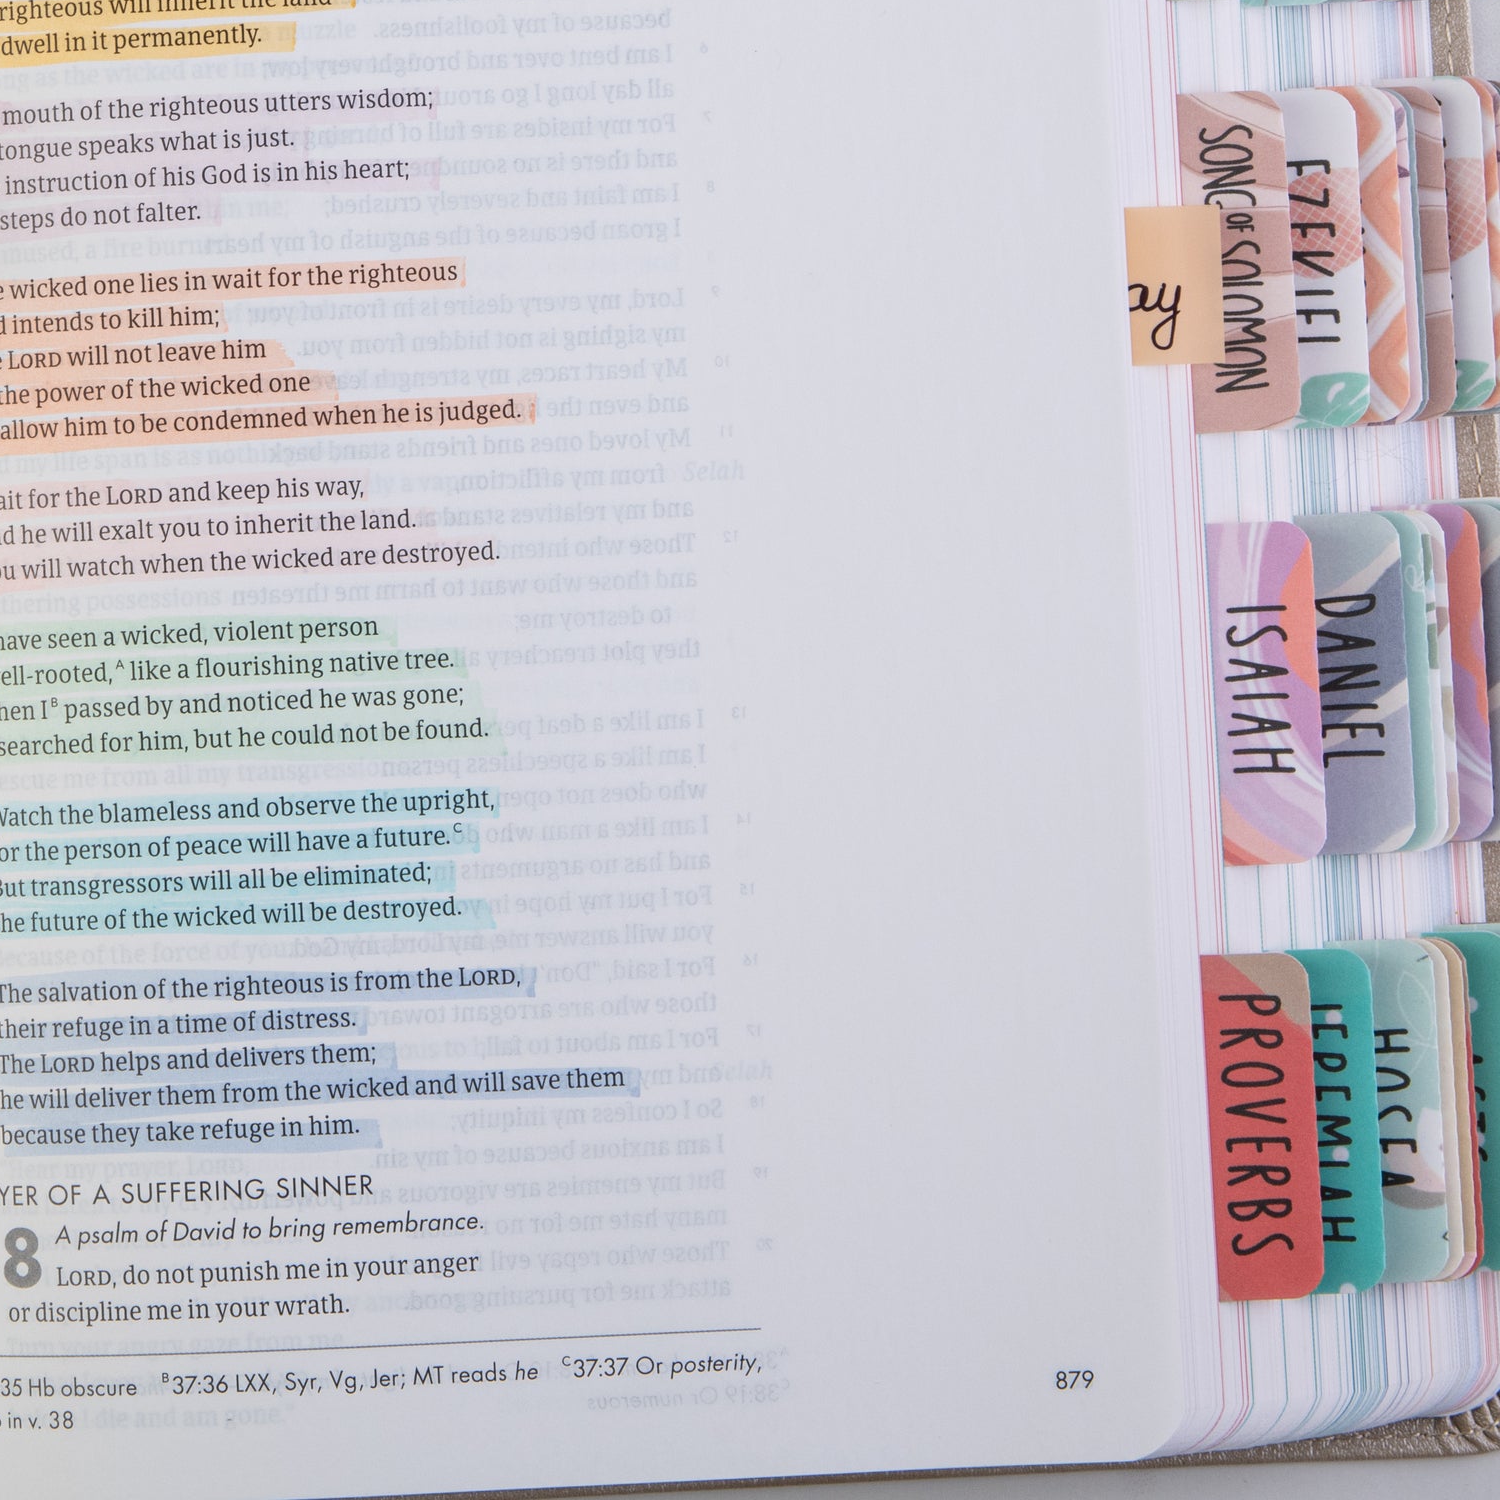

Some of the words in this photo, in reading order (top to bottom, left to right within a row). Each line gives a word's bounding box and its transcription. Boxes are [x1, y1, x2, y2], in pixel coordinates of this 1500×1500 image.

[1, 101, 75, 126] mouth
[79, 99, 103, 121] of
[107, 98, 144, 120] the
[148, 95, 259, 122] righteous
[264, 93, 332, 113] utters
[336, 87, 433, 110] wisdom;
[1198, 124, 1257, 210] SONG
[1225, 212, 1255, 233] OF
[8, 275, 88, 300] wicked
[93, 278, 135, 296] one
[139, 272, 179, 294] lies
[183, 270, 208, 292] in
[211, 267, 263, 290] wait
[267, 266, 302, 288] for
[306, 264, 344, 287] the
[348, 262, 458, 289] righteous
[27, 488, 61, 509] for
[65, 486, 101, 508] the
[105, 485, 163, 506] LORD
[168, 480, 212, 503] and
[215, 480, 271, 505] keep
[275, 477, 310, 499] his
[314, 479, 364, 501] way,
[47, 631, 98, 649] seen
[103, 630, 116, 647] a
[120, 621, 208, 646] wicked,
[212, 619, 295, 643] violent
[298, 620, 380, 644] person
[1224, 605, 1296, 774] ISAIAH
[1314, 593, 1385, 769] DANIEL
[30, 875, 184, 901] transgressors
[188, 868, 233, 892] will
[238, 867, 266, 890] all
[269, 867, 298, 889] be
[303, 860, 432, 887] eliminated;
[1218, 994, 1295, 1257] PROVERBS
[1373, 1028, 1417, 1188] HOSEA
[48, 1184, 81, 1206] OF
[92, 1183, 111, 1205] A
[121, 1178, 265, 1205] SUFFERING
[276, 1174, 374, 1200] SINNER
[54, 1224, 72, 1245] A
[77, 1220, 139, 1251] psalm
[145, 1218, 169, 1243] of
[173, 1216, 237, 1242] David
[242, 1221, 262, 1240] to
[268, 1215, 326, 1243] bring
[332, 1209, 484, 1236] remembrance.
[28, 1376, 55, 1397] Hb
[60, 1376, 138, 1398] obscure
[235, 1372, 277, 1396] LXX,
[284, 1371, 322, 1397] Syr,
[328, 1369, 364, 1395] Vg,
[370, 1368, 406, 1390] Jer;
[413, 1365, 445, 1386] MT
[451, 1361, 507, 1384] reads
[514, 1359, 539, 1381] he
[635, 1355, 664, 1375] Or
[670, 1353, 762, 1380] posterity,
[1055, 1369, 1095, 1390] 879
[7, 1411, 22, 1429] in
[27, 1416, 42, 1430] v.
[49, 1410, 74, 1430] 38
